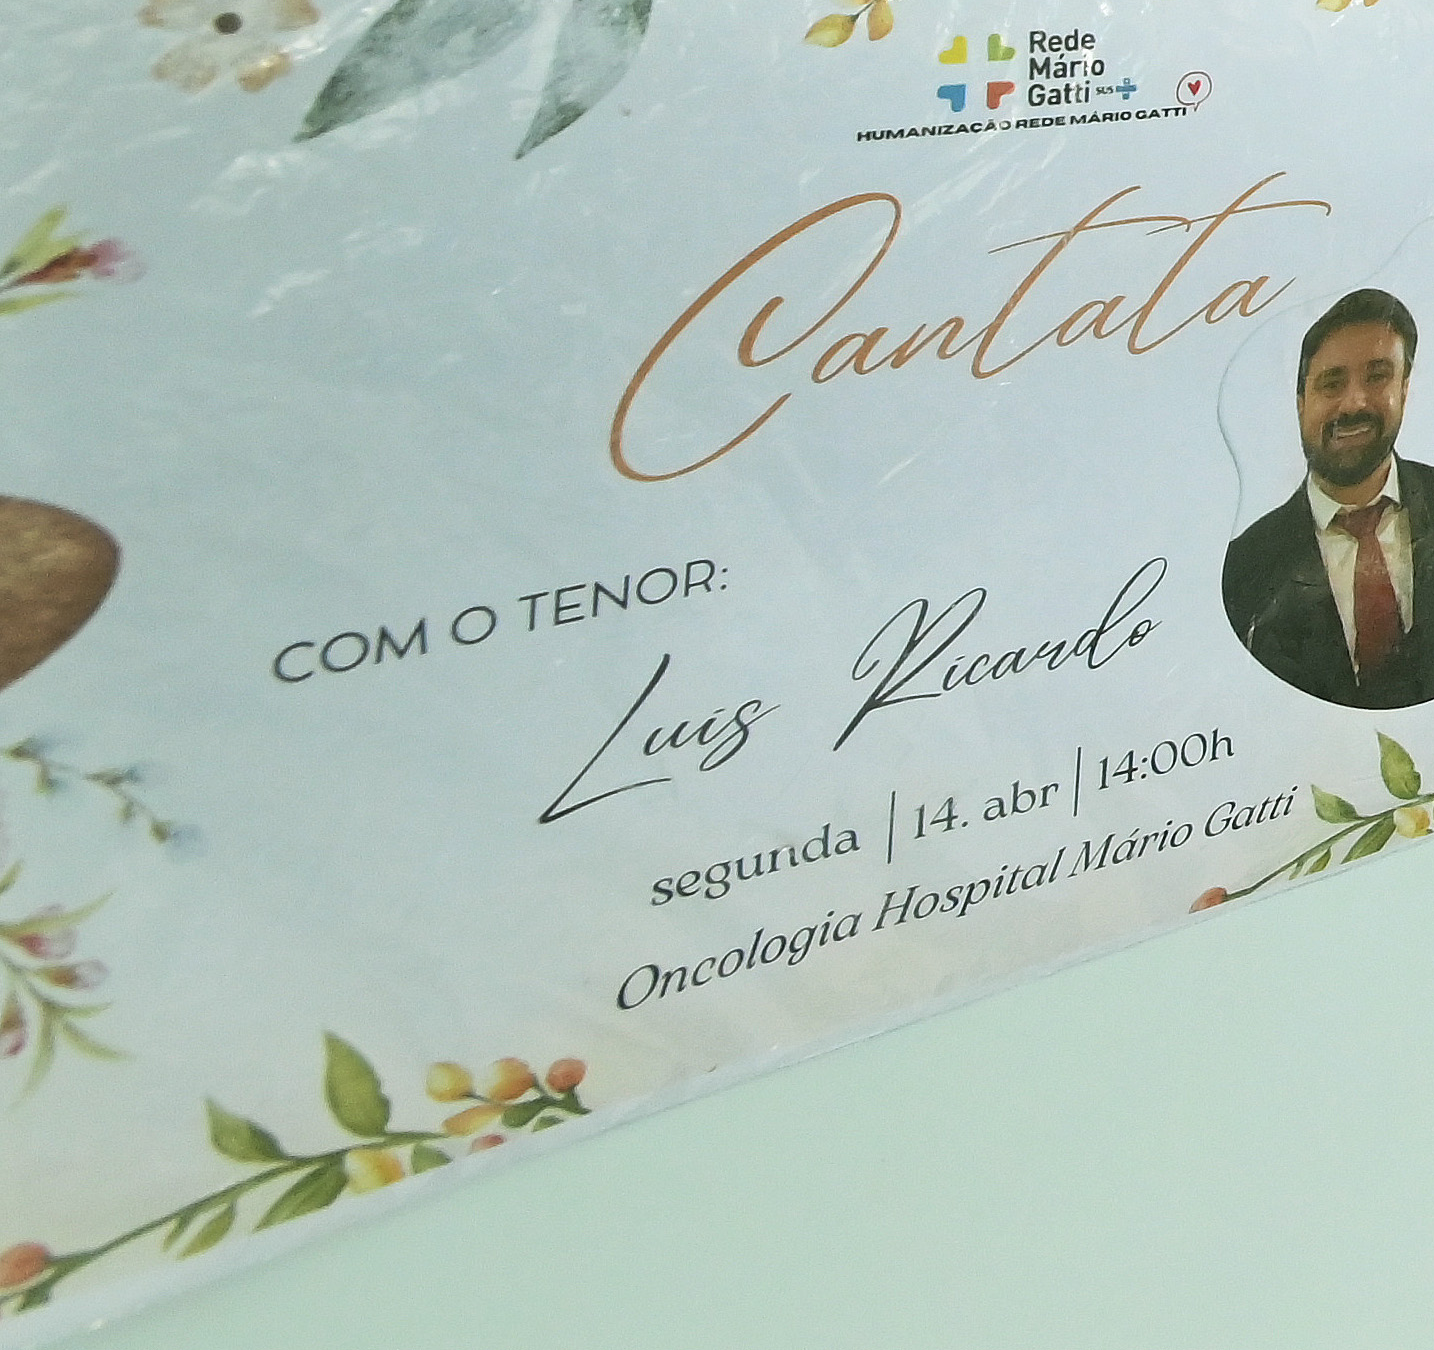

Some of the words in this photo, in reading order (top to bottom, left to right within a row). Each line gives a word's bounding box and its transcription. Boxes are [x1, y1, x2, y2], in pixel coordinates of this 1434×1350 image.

[1028, 80, 1090, 106] Gatti
[1029, 53, 1104, 80] Mário
[1030, 29, 1095, 53] Rede
[1015, 116, 1066, 129] REDE
[1070, 111, 1131, 124] MÁRIO
[1136, 107, 1186, 119] GATTI
[609, 172, 1331, 482] Cantata
[274, 618, 427, 683] COM
[451, 606, 496, 645] O
[519, 560, 727, 631] TENOR:
[538, 654, 780, 824] Luis
[833, 558, 1167, 751] Ricardo
[652, 823, 860, 906] segunda
[915, 798, 968, 839] 14.
[984, 780, 1058, 820] abr
[1099, 729, 1234, 790] 14:00h
[617, 911, 862, 1010] Oncologia
[872, 847, 1066, 931] Hospital
[1068, 821, 1192, 877] Mário
[1205, 786, 1297, 836] Gatti
